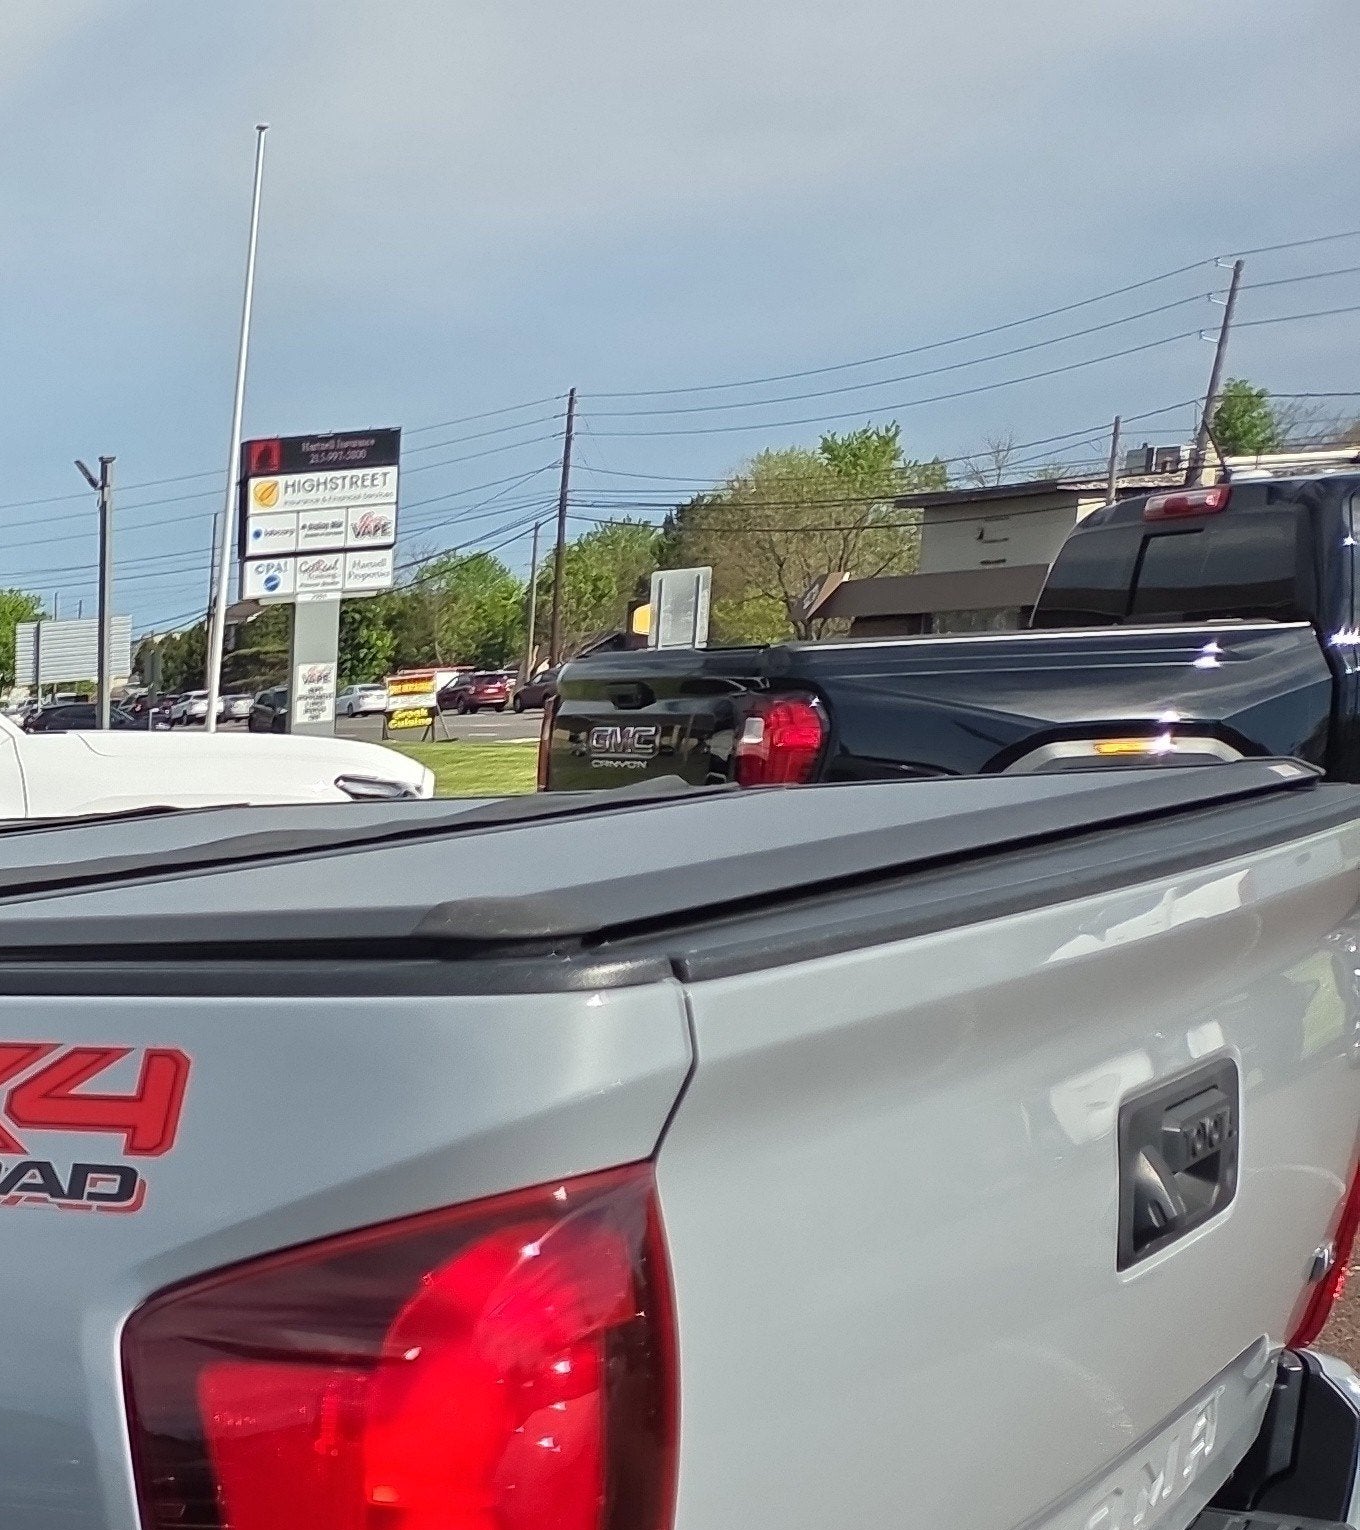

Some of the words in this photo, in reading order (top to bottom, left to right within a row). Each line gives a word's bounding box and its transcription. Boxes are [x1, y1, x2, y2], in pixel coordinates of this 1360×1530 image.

[284, 472, 390, 495] HIGHSTREET
[590, 726, 657, 753] GMC
[591, 759, 648, 769] CANYON
